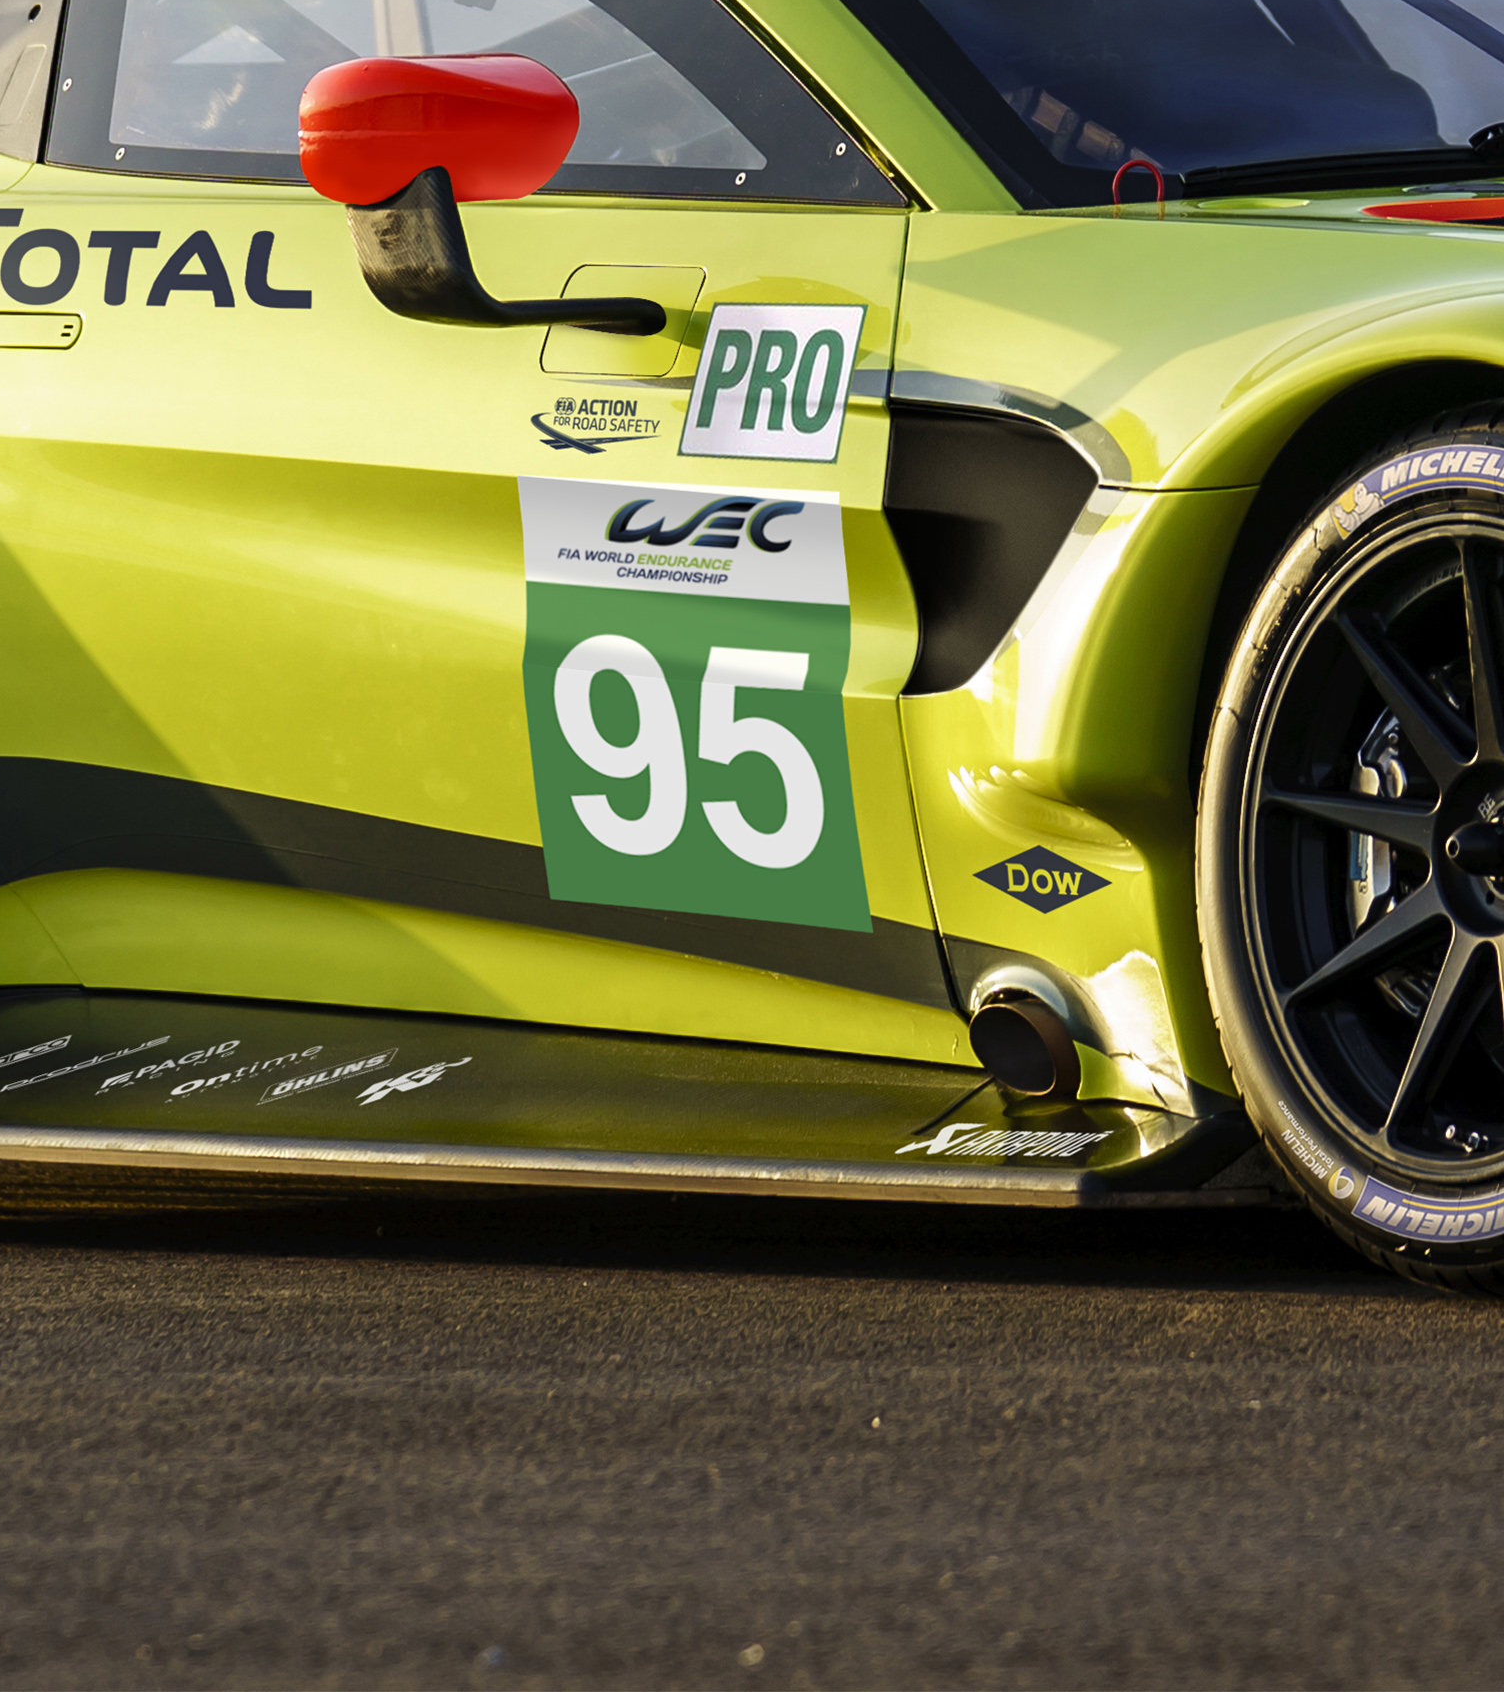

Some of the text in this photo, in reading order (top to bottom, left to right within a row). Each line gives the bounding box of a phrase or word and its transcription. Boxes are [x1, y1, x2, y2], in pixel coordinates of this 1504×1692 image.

[695, 329, 845, 434] PRO
[553, 416, 661, 434] FOR ROAD SAFETY
[577, 399, 638, 417] ACTION
[604, 495, 805, 553] WEC
[557, 548, 733, 572] FIA WORLD ENDURANCE
[616, 566, 728, 585] CHAMPIONSHIP
[553, 634, 824, 869] 95
[1004, 862, 1083, 896] DOW
[135, 1040, 241, 1078] PAGID
[170, 1045, 324, 1096] Ontime
[1278, 1100, 1336, 1170] Total Performance
[1281, 1129, 1329, 1179] MICHELIN
